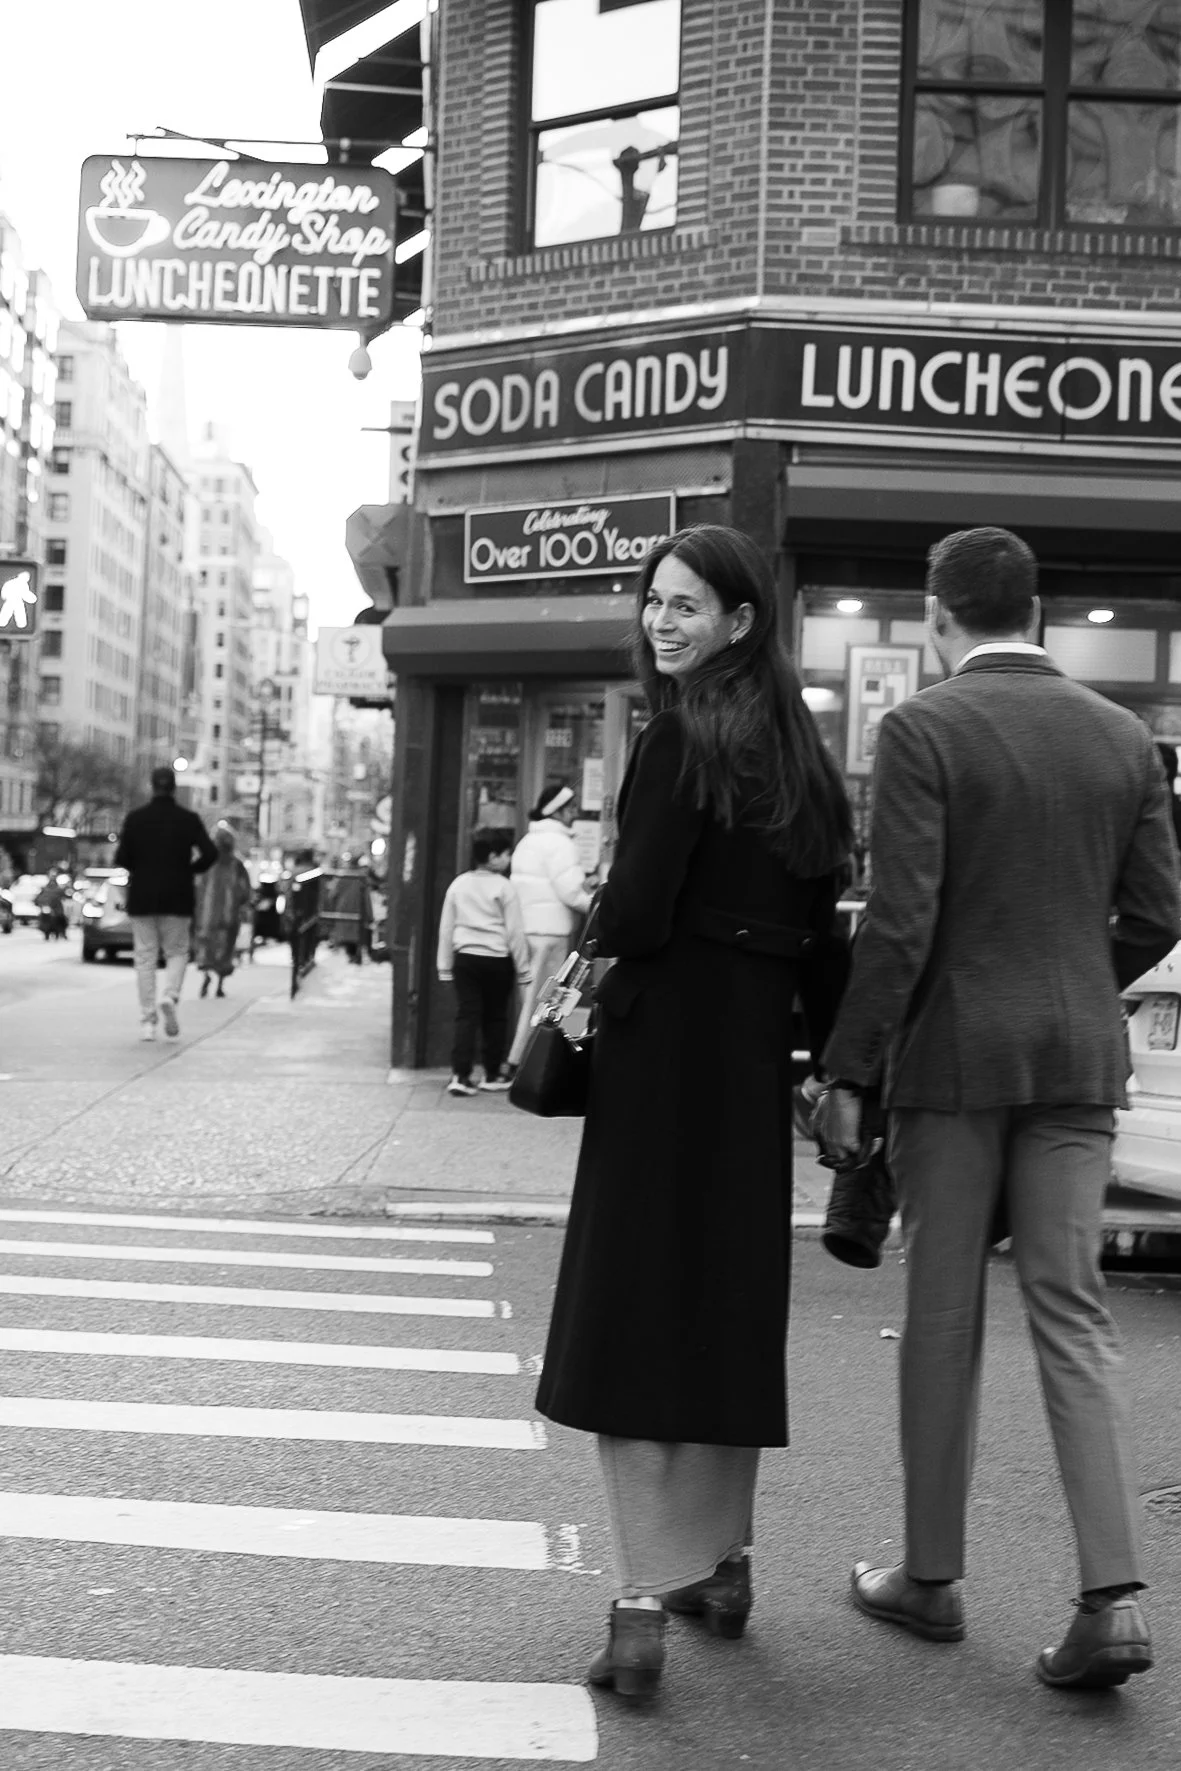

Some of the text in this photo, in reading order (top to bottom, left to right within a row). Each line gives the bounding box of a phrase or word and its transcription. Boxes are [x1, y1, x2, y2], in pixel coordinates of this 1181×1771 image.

[184, 161, 380, 224] Lexington
[173, 206, 394, 267] Candy Shop
[88, 255, 382, 318] LUNCHEONETTE
[433, 346, 729, 440] SODA CANDY
[470, 526, 668, 572] Over 100 Year
[522, 504, 612, 535] Celebrating
